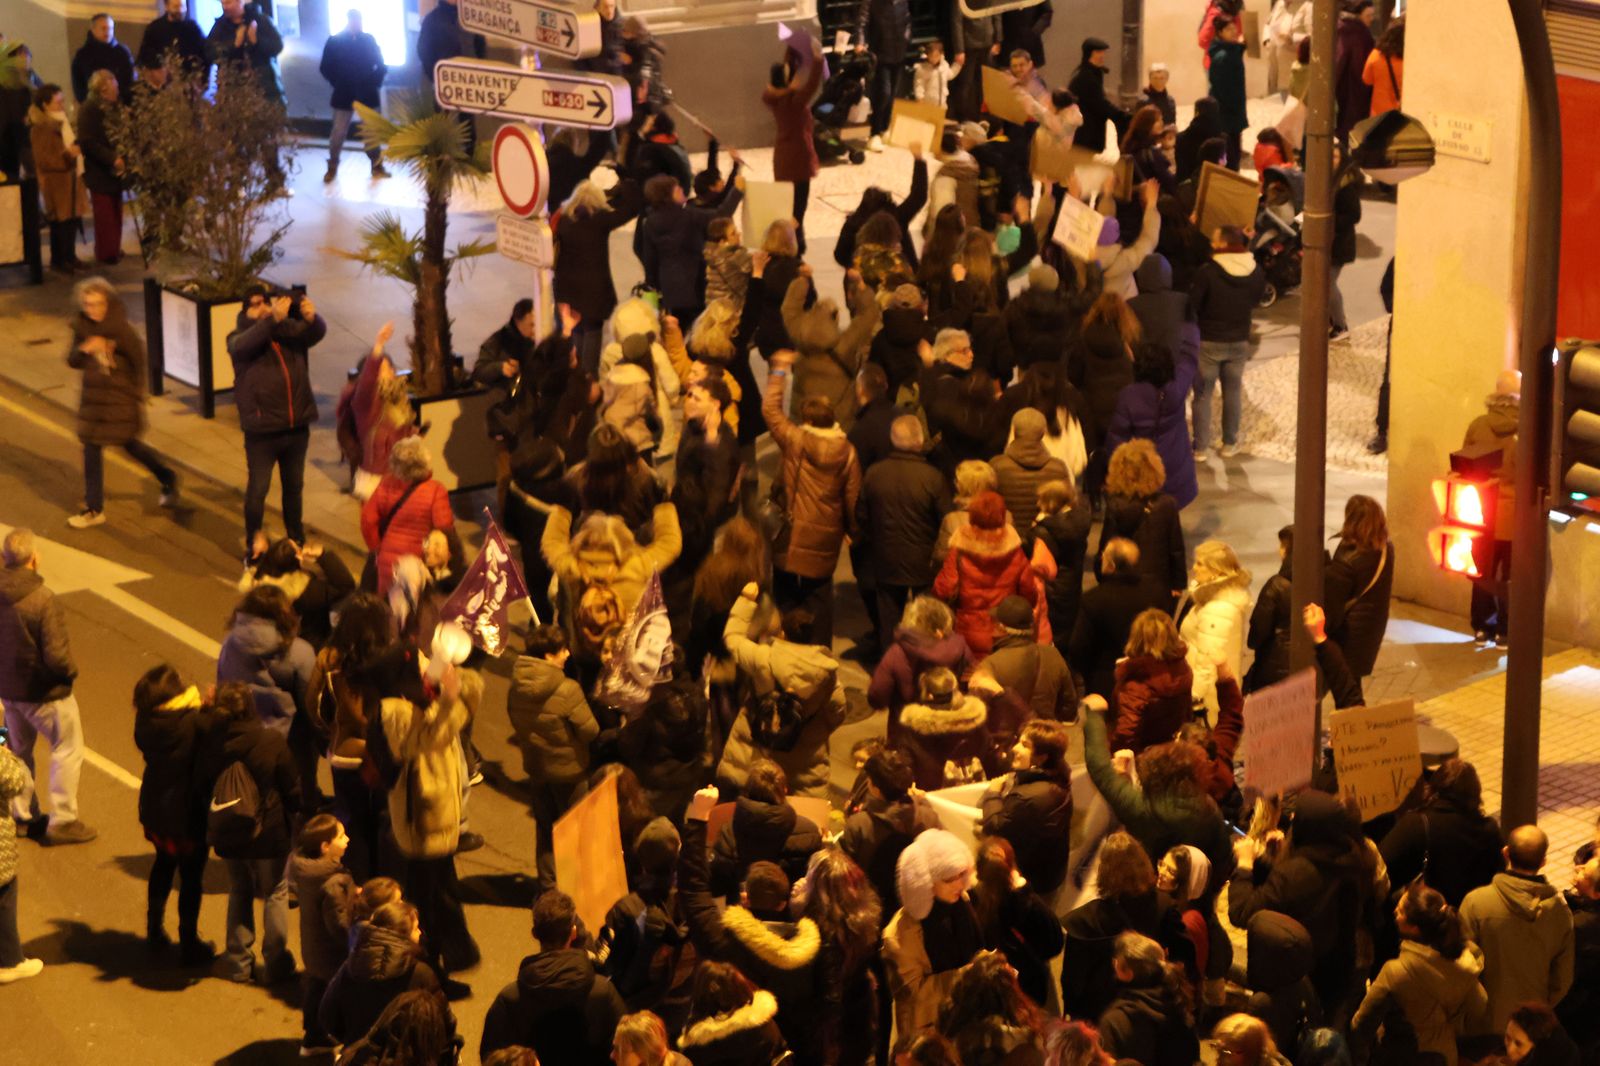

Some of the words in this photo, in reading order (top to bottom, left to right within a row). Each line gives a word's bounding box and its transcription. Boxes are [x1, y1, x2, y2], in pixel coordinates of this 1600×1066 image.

[464, 6, 521, 34] BRAGANÇA
[442, 70, 517, 91] BENAVENTE
[442, 84, 506, 107] ORENSE
[543, 91, 584, 109] N-630
